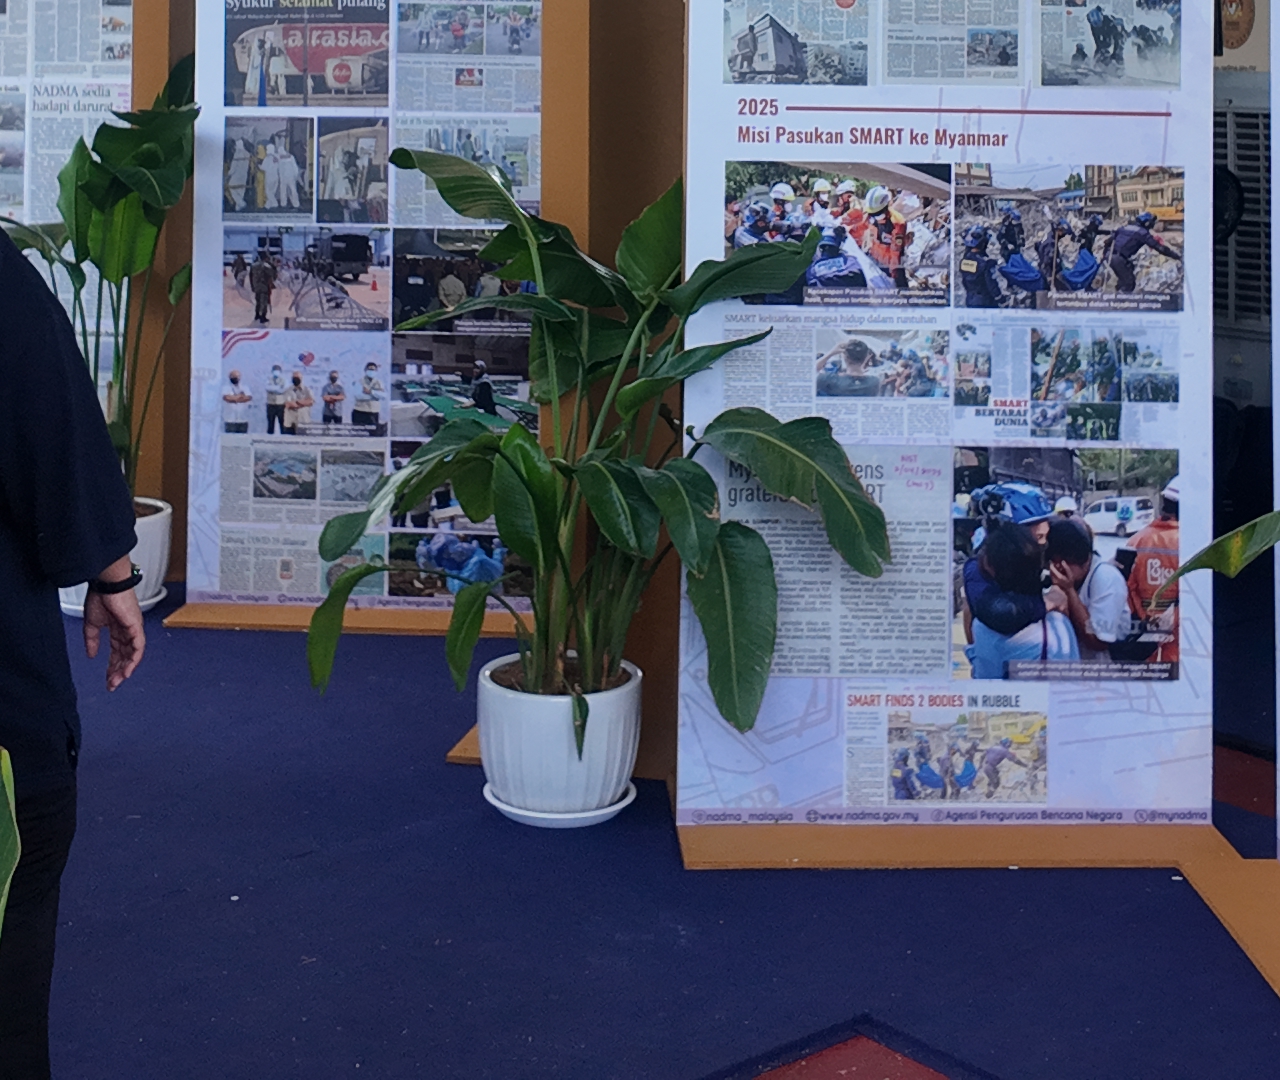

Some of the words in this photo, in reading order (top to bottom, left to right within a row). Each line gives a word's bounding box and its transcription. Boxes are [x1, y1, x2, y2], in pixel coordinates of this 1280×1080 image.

[33, 84, 78, 98] NADMA
[82, 86, 111, 98] sedia
[32, 100, 70, 114] hadapi
[74, 100, 114, 112] darurat
[737, 98, 778, 116] 2025
[737, 126, 770, 144] Misi
[776, 127, 844, 146] Pasukan
[849, 128, 903, 146] SMART
[909, 128, 930, 146] ke
[934, 129, 1008, 148] Myanmar
[724, 314, 756, 322] SMART
[804, 315, 838, 325] mangsa
[840, 314, 866, 324] hidup
[867, 314, 894, 324] dalam
[896, 314, 937, 324] runtuhan
[975, 408, 1028, 416] BERTARAF
[994, 418, 1028, 426] DUNIA
[728, 487, 787, 506] grate
[847, 694, 882, 707] SMART
[885, 694, 914, 707] FINDS
[918, 694, 924, 707] 2
[928, 694, 964, 707] BODIES
[968, 695, 978, 708] IN
[982, 695, 1020, 708] RUBBLE
[820, 812, 918, 822] www.nadma.gov.my
[945, 810, 978, 822] Agensi
[980, 811, 1038, 822] Pengurusan
[1041, 811, 1083, 820] Bencana
[1086, 811, 1122, 822] Negara
